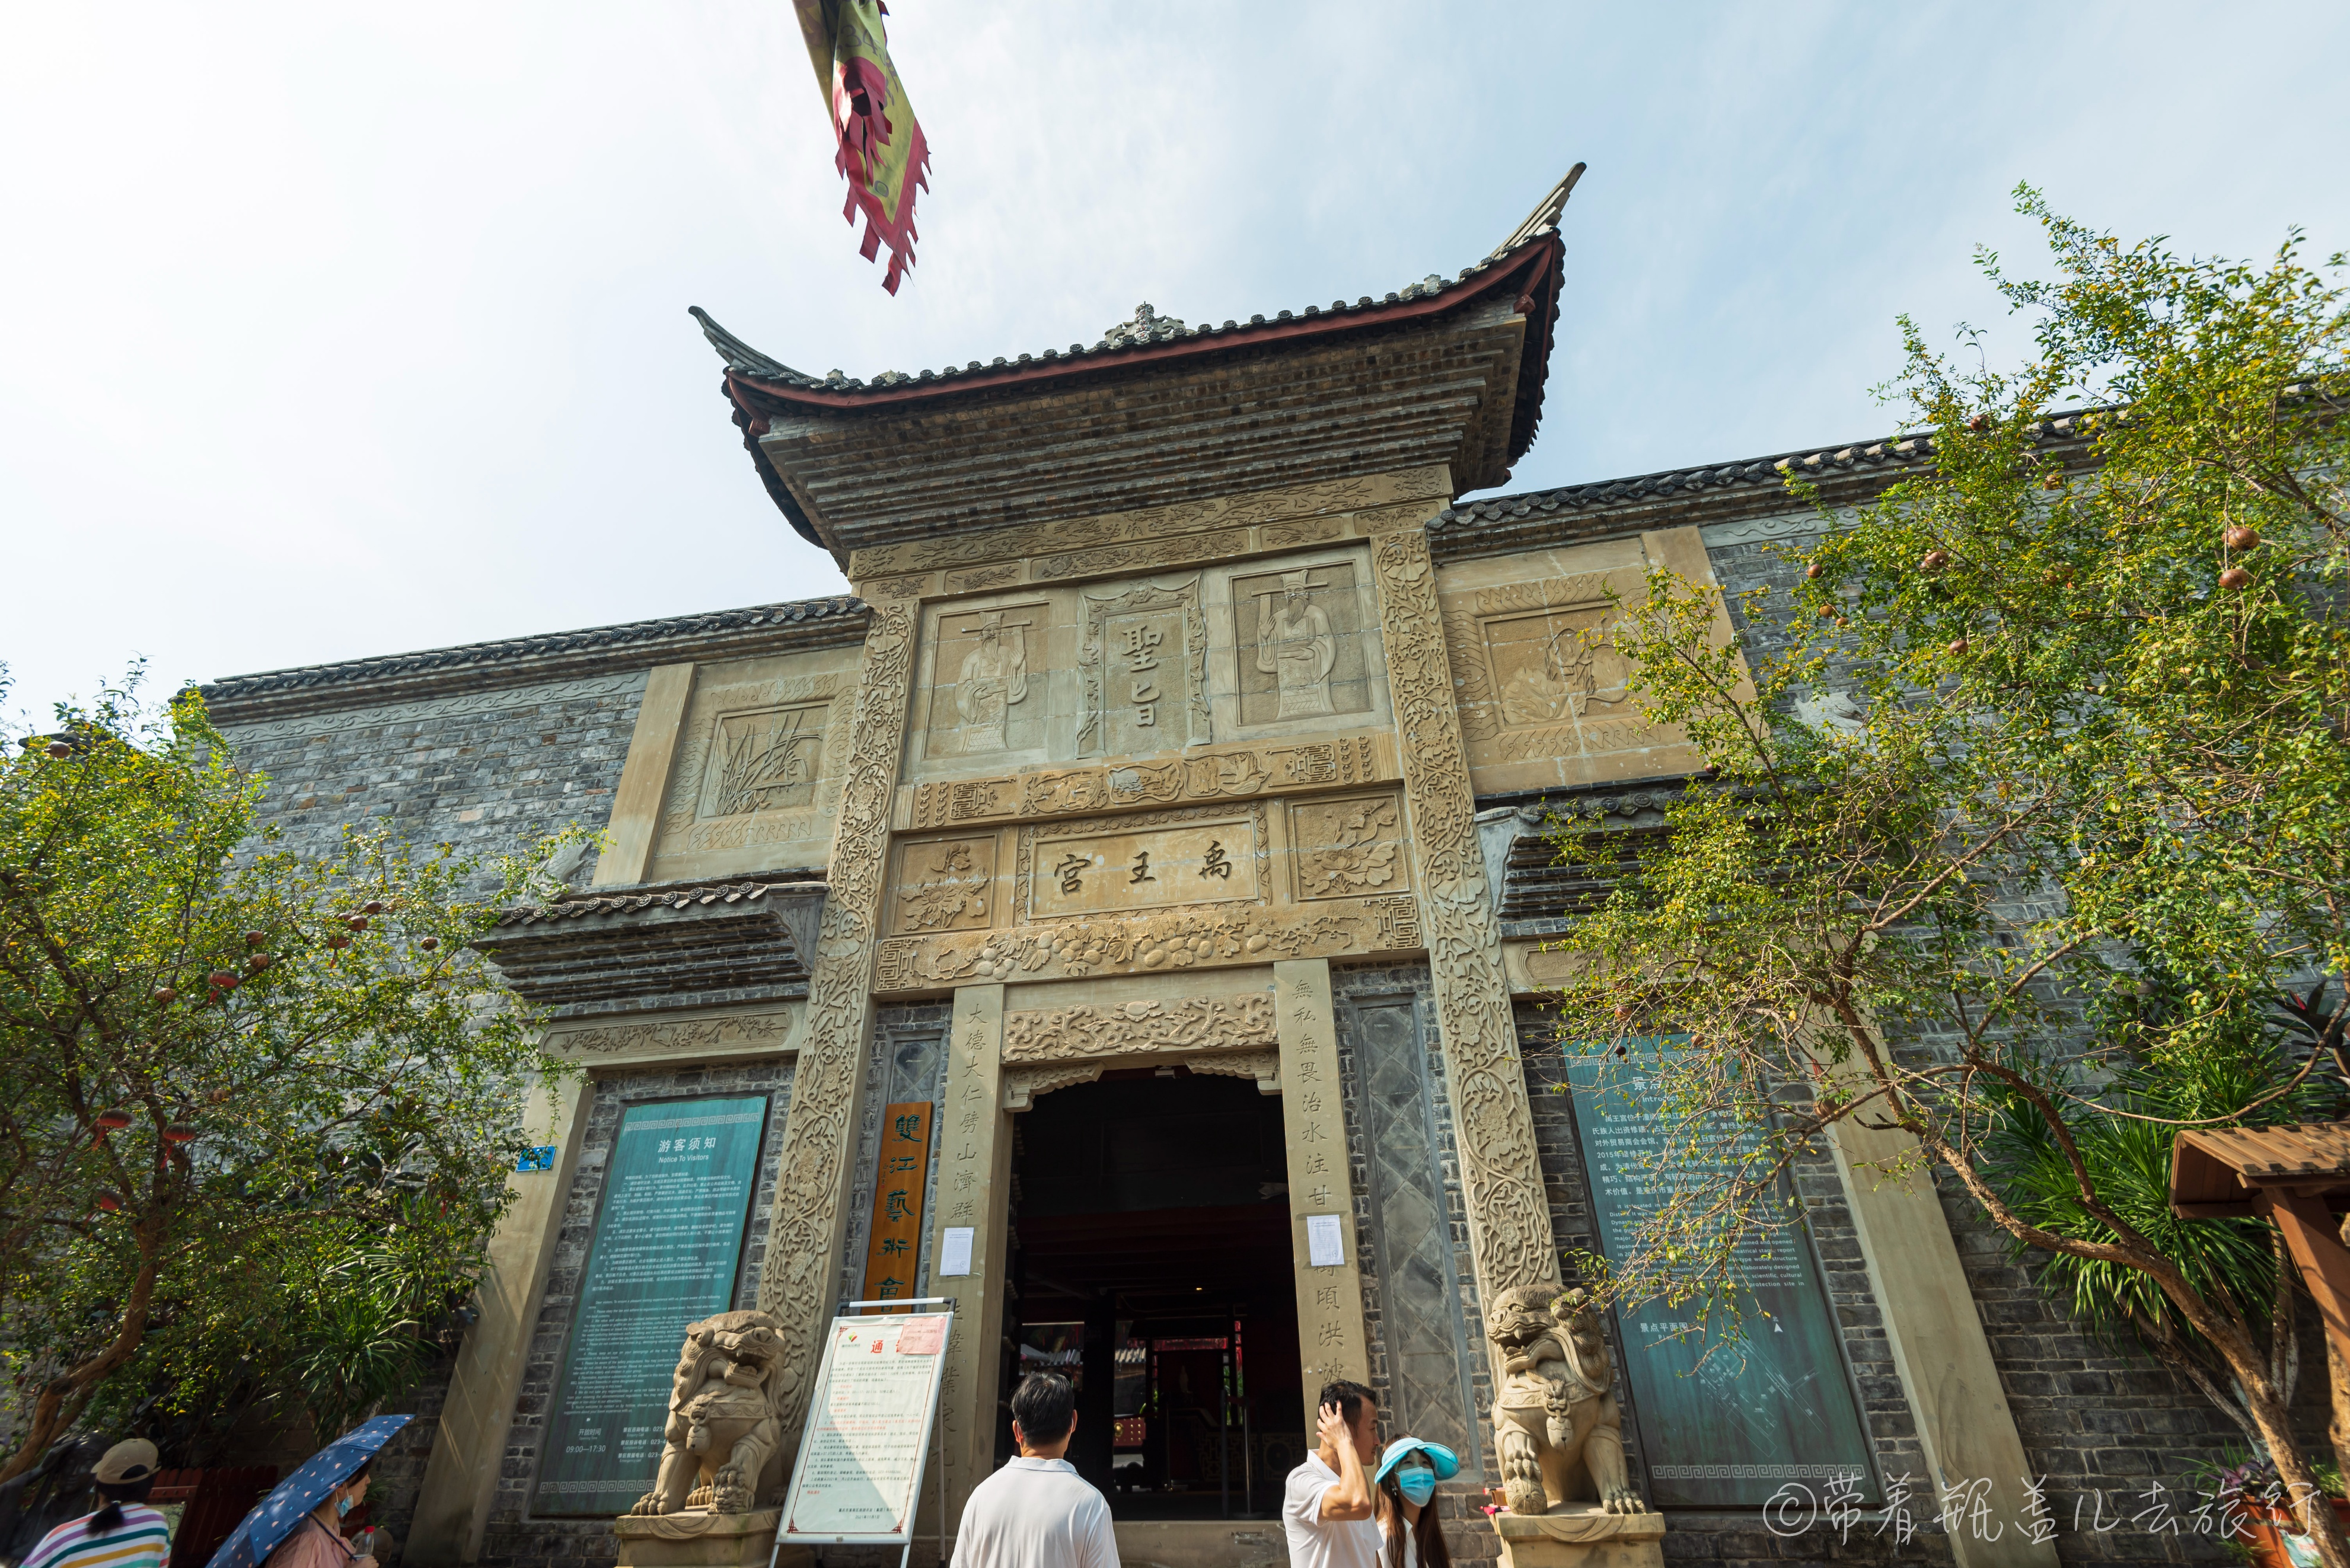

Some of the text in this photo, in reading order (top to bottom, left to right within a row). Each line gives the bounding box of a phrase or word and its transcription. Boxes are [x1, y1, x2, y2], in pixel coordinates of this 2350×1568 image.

[1121, 623, 1163, 727] 聖旨
[658, 1137, 716, 1152] 游客须知
[687, 1154, 710, 1162] Visitors
[1640, 1322, 1688, 1333] 景点平面图
